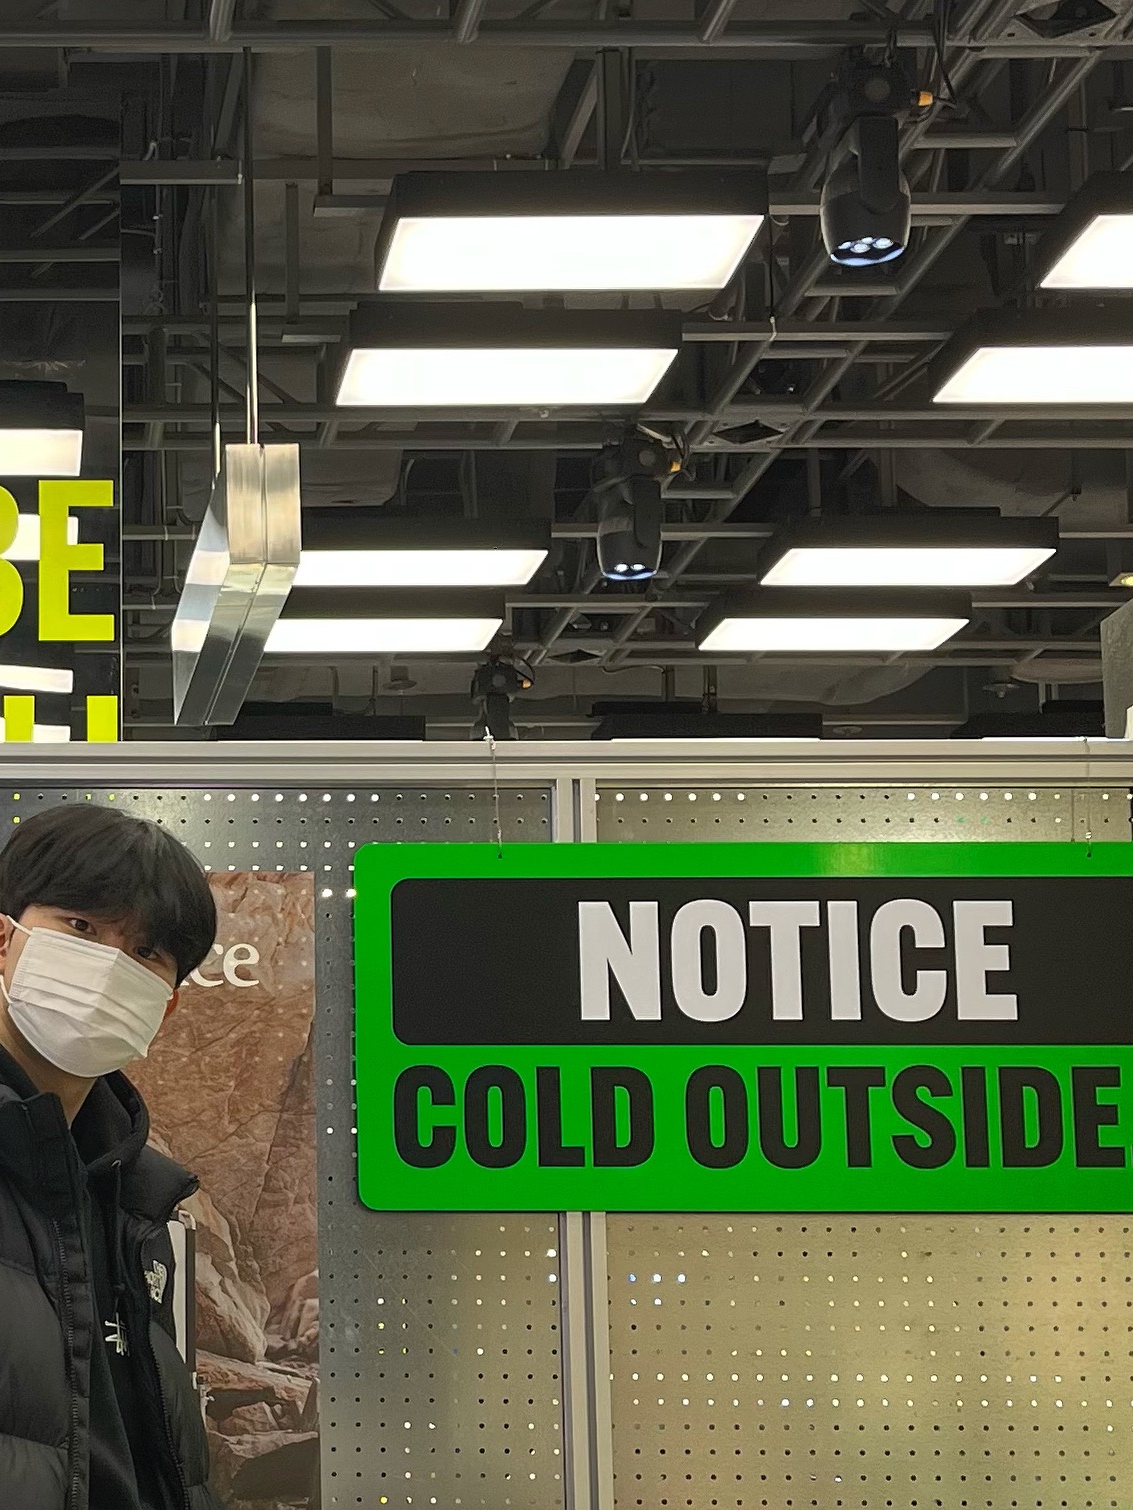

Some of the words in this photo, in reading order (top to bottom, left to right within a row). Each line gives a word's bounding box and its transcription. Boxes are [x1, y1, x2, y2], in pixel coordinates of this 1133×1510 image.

[577, 898, 1019, 1022] NOTICE
[392, 1064, 656, 1170] COLD
[684, 1064, 1133, 1170] OUTSIDE
